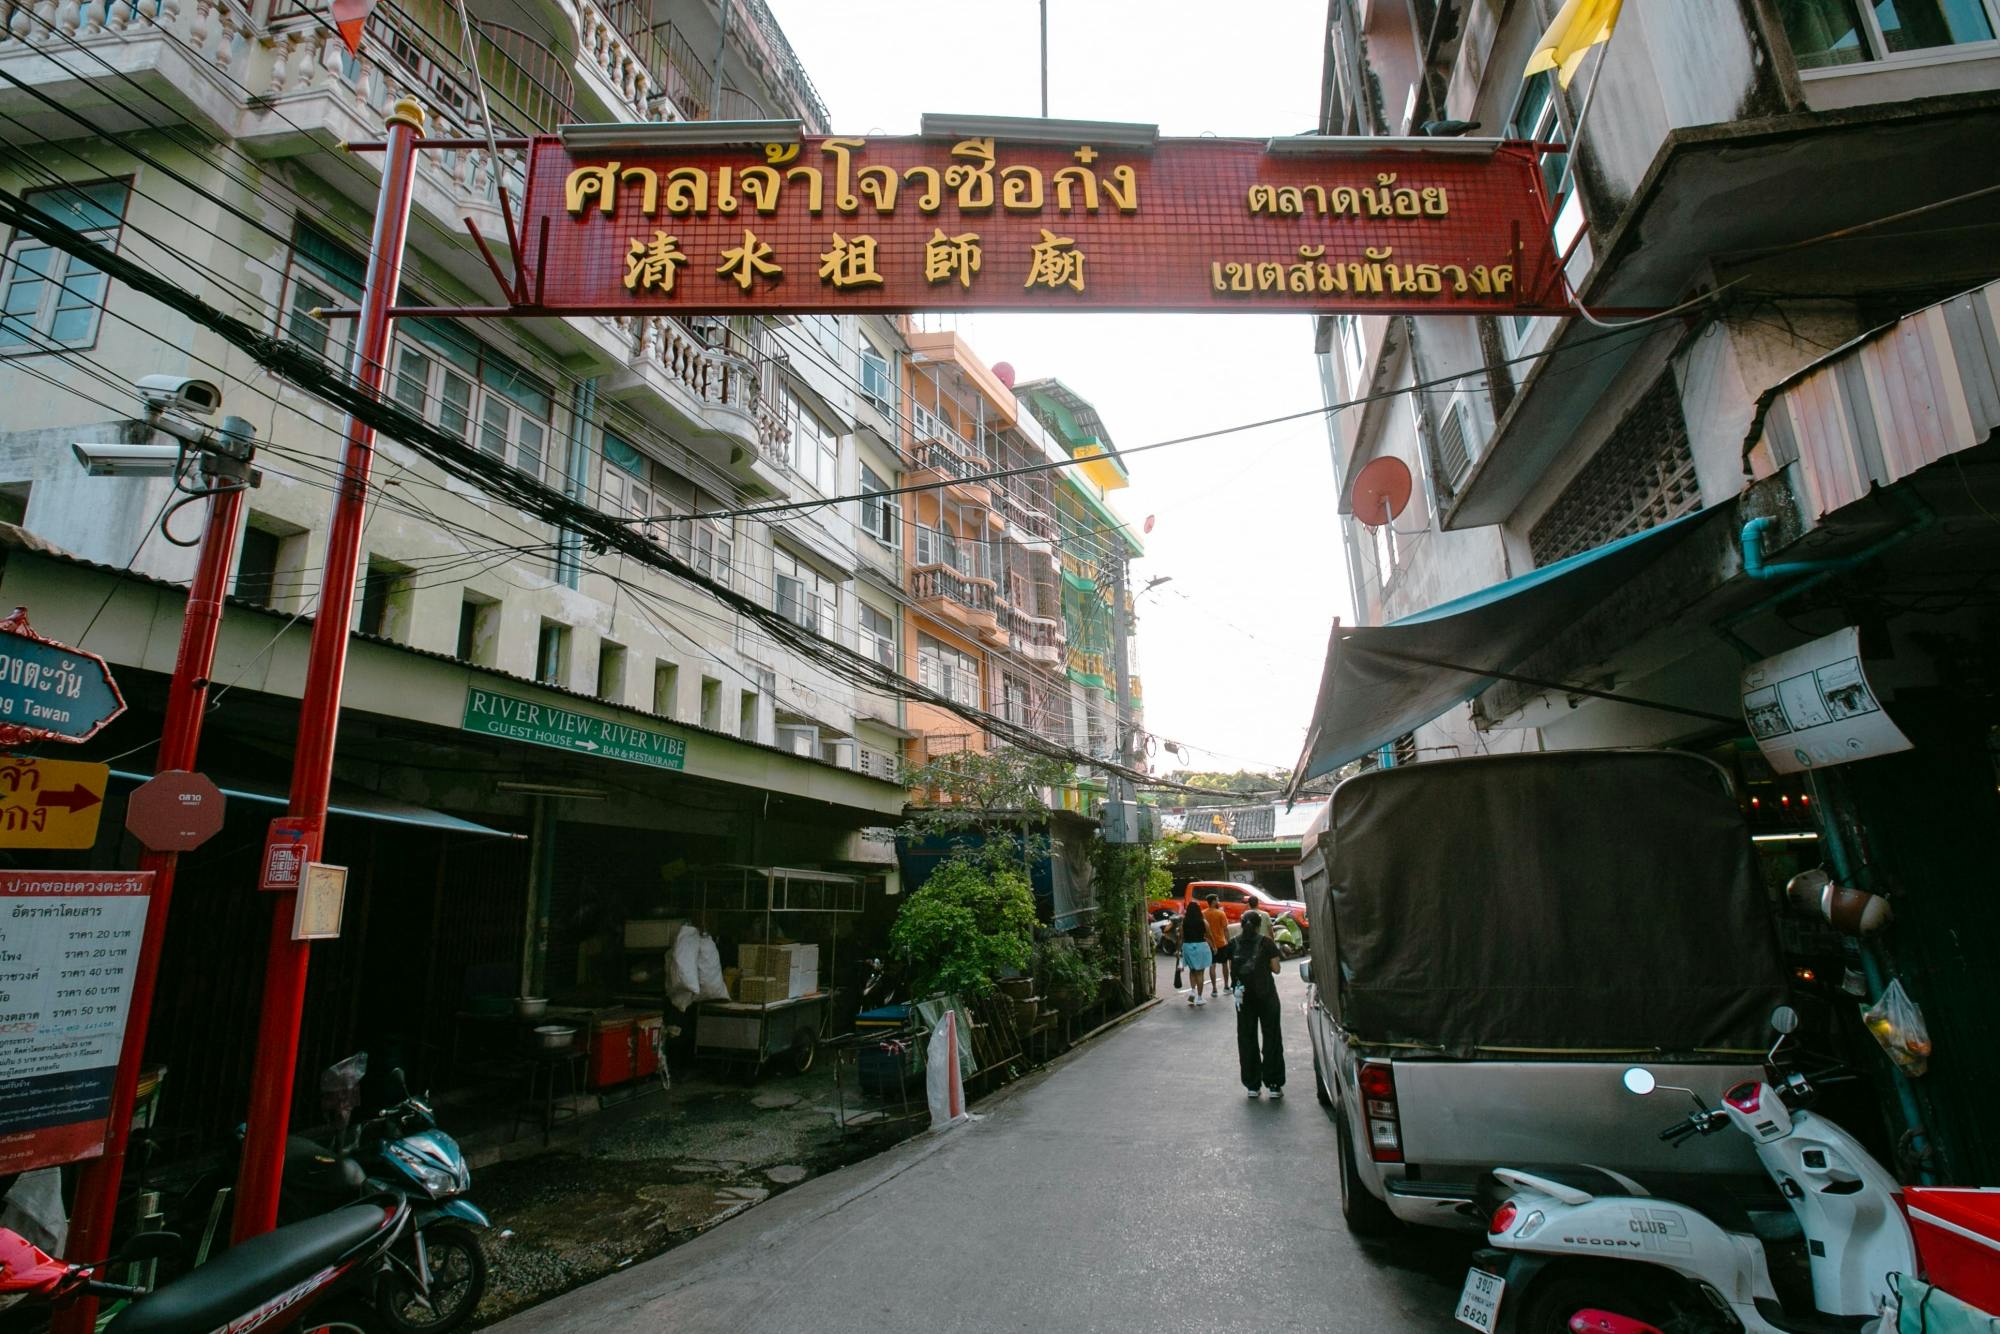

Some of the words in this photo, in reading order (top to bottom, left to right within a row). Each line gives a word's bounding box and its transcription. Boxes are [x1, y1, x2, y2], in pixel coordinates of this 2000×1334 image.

[565, 137, 1137, 214] ศาลเจ้าโจวซือก๋ง
[1248, 172, 1448, 218] ตลาดน้อย
[623, 228, 1086, 293] 清水祖師廟
[24, 698, 70, 722] Tawan
[473, 692, 540, 726] RIVER
[601, 724, 647, 750] RIVER
[652, 735, 684, 757] VIBE
[488, 721, 533, 739] GUEST
[536, 731, 573, 747] HOUSE
[602, 746, 620, 758] BAR
[629, 751, 680, 769] RESTAURANT
[7, 878, 143, 893] ปากซอยดวงตะวัน
[69, 931, 93, 940] ราคา
[97, 930, 110, 939] 20
[113, 929, 131, 938] บาท
[65, 951, 89, 959] ราคา
[93, 949, 106, 958] 20
[109, 948, 127, 957] บาท
[61, 970, 85, 978] ราคา
[89, 968, 101, 976] 40
[105, 967, 124, 976] บาท
[57, 989, 81, 998] ราคา
[85, 987, 97, 996] 60
[101, 985, 120, 995] บาท
[52, 1009, 77, 1018] ราคา
[80, 1006, 93, 1015] 50
[97, 1005, 116, 1014] บาท
[1629, 1220, 1668, 1235] CLUB
[1563, 1237, 1641, 1248] SCOOPY
